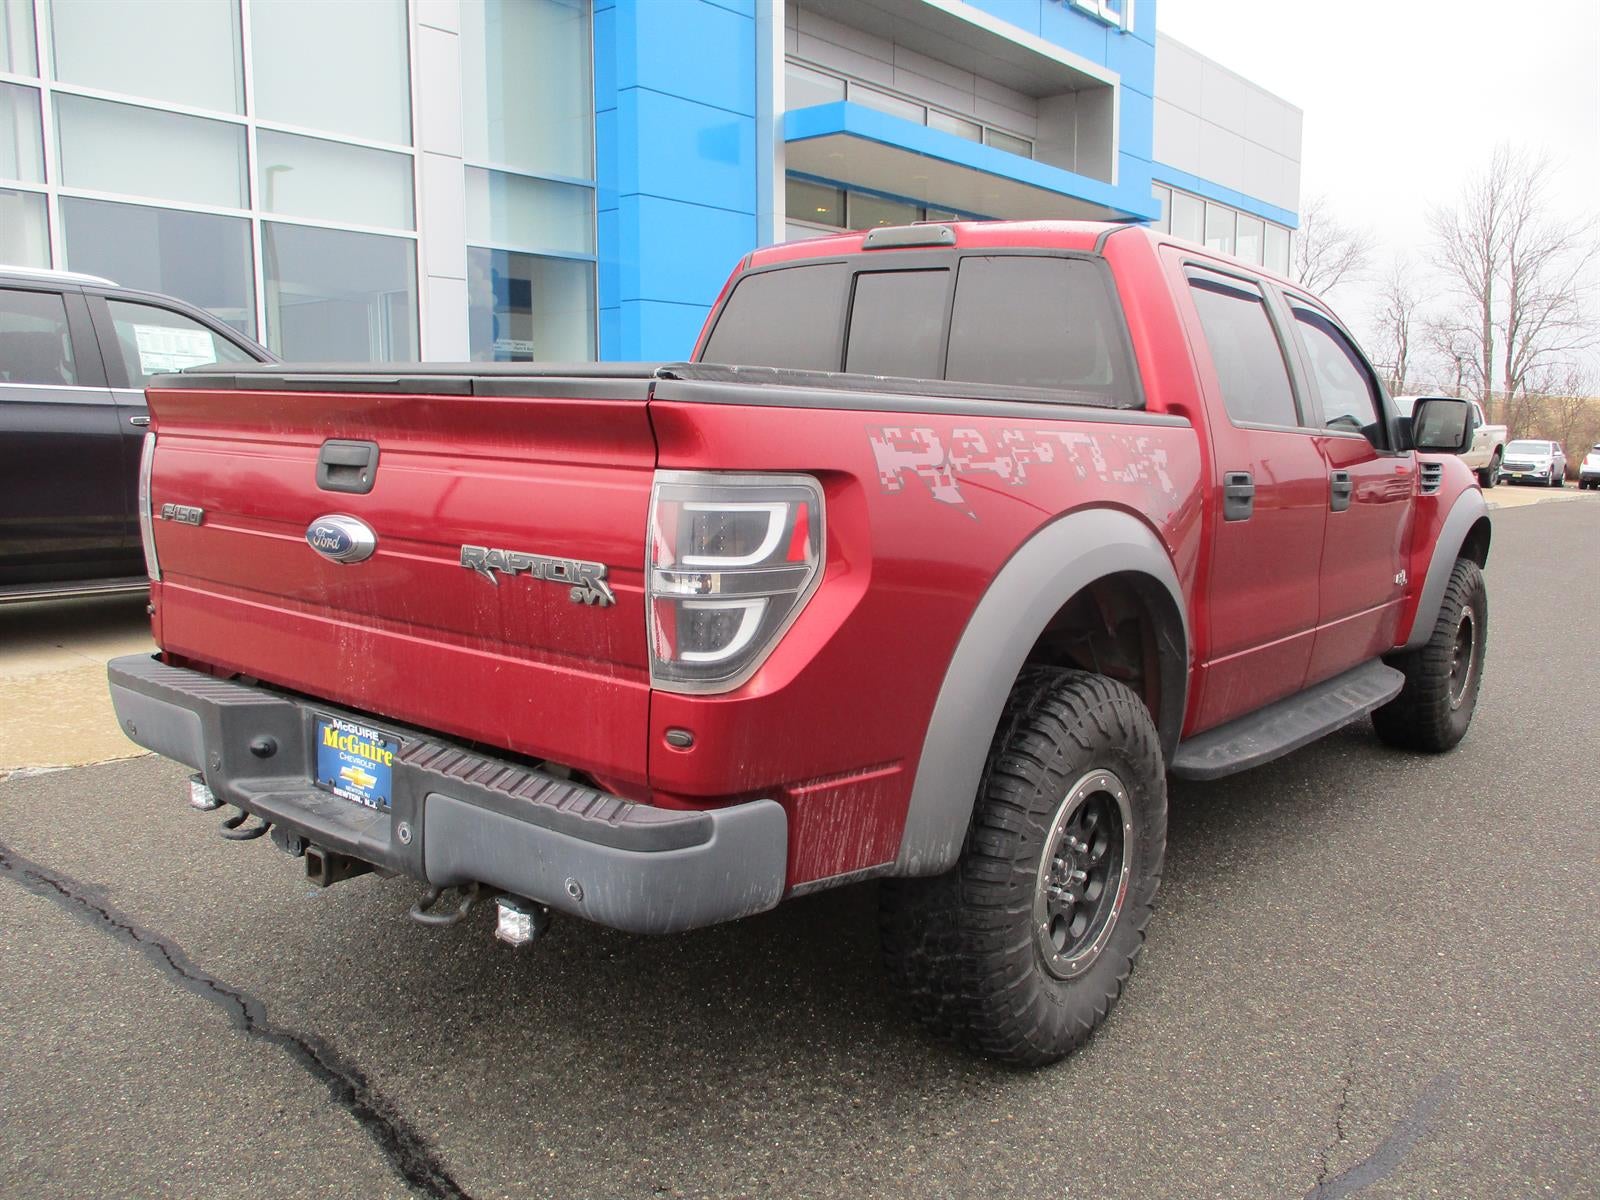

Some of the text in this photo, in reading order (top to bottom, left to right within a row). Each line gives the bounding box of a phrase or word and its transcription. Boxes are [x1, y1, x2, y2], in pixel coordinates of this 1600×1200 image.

[313, 526, 341, 550] Ford
[460, 543, 616, 605] RAPTOR
[323, 726, 393, 767] McGuire
